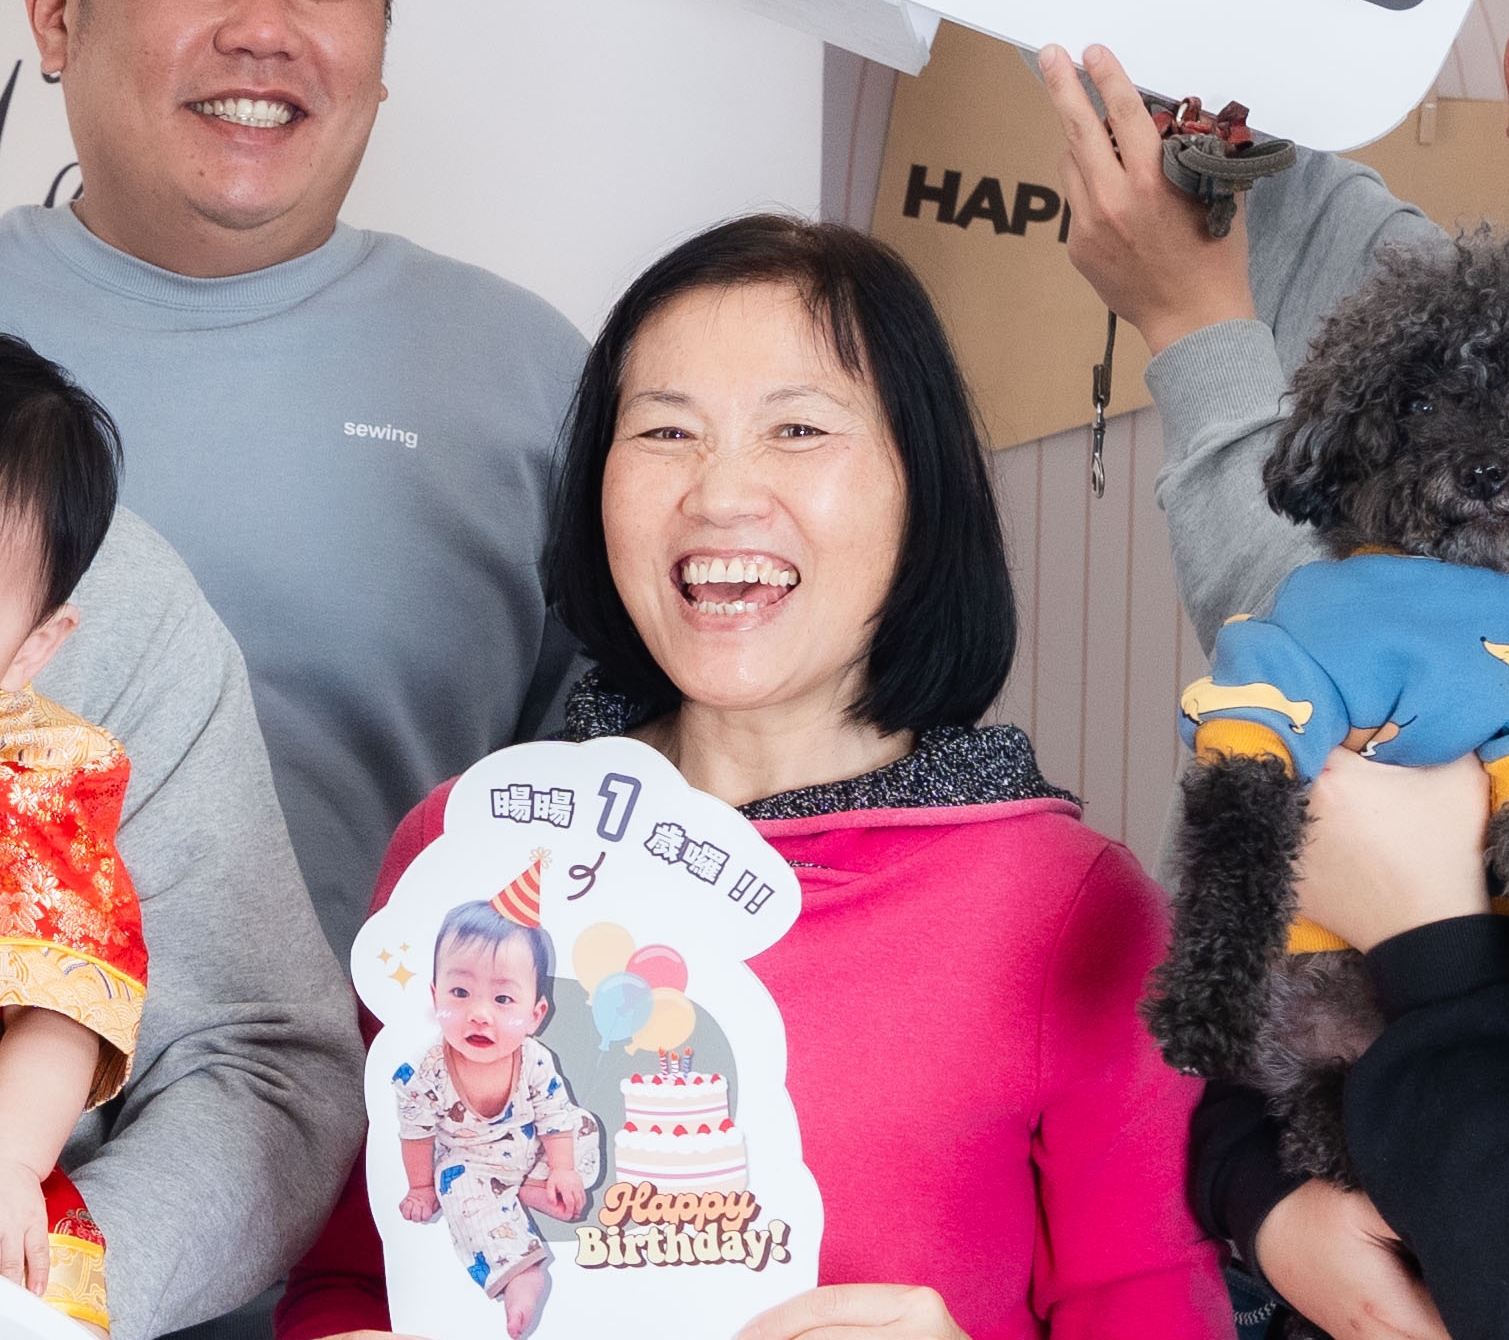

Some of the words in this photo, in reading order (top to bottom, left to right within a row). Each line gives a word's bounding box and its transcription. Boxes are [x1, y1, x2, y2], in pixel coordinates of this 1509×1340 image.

[902, 164, 1072, 244] HAP
[344, 421, 418, 449] sewing
[598, 1180, 762, 1233] Happy
[575, 1219, 792, 1272] Birthday!
